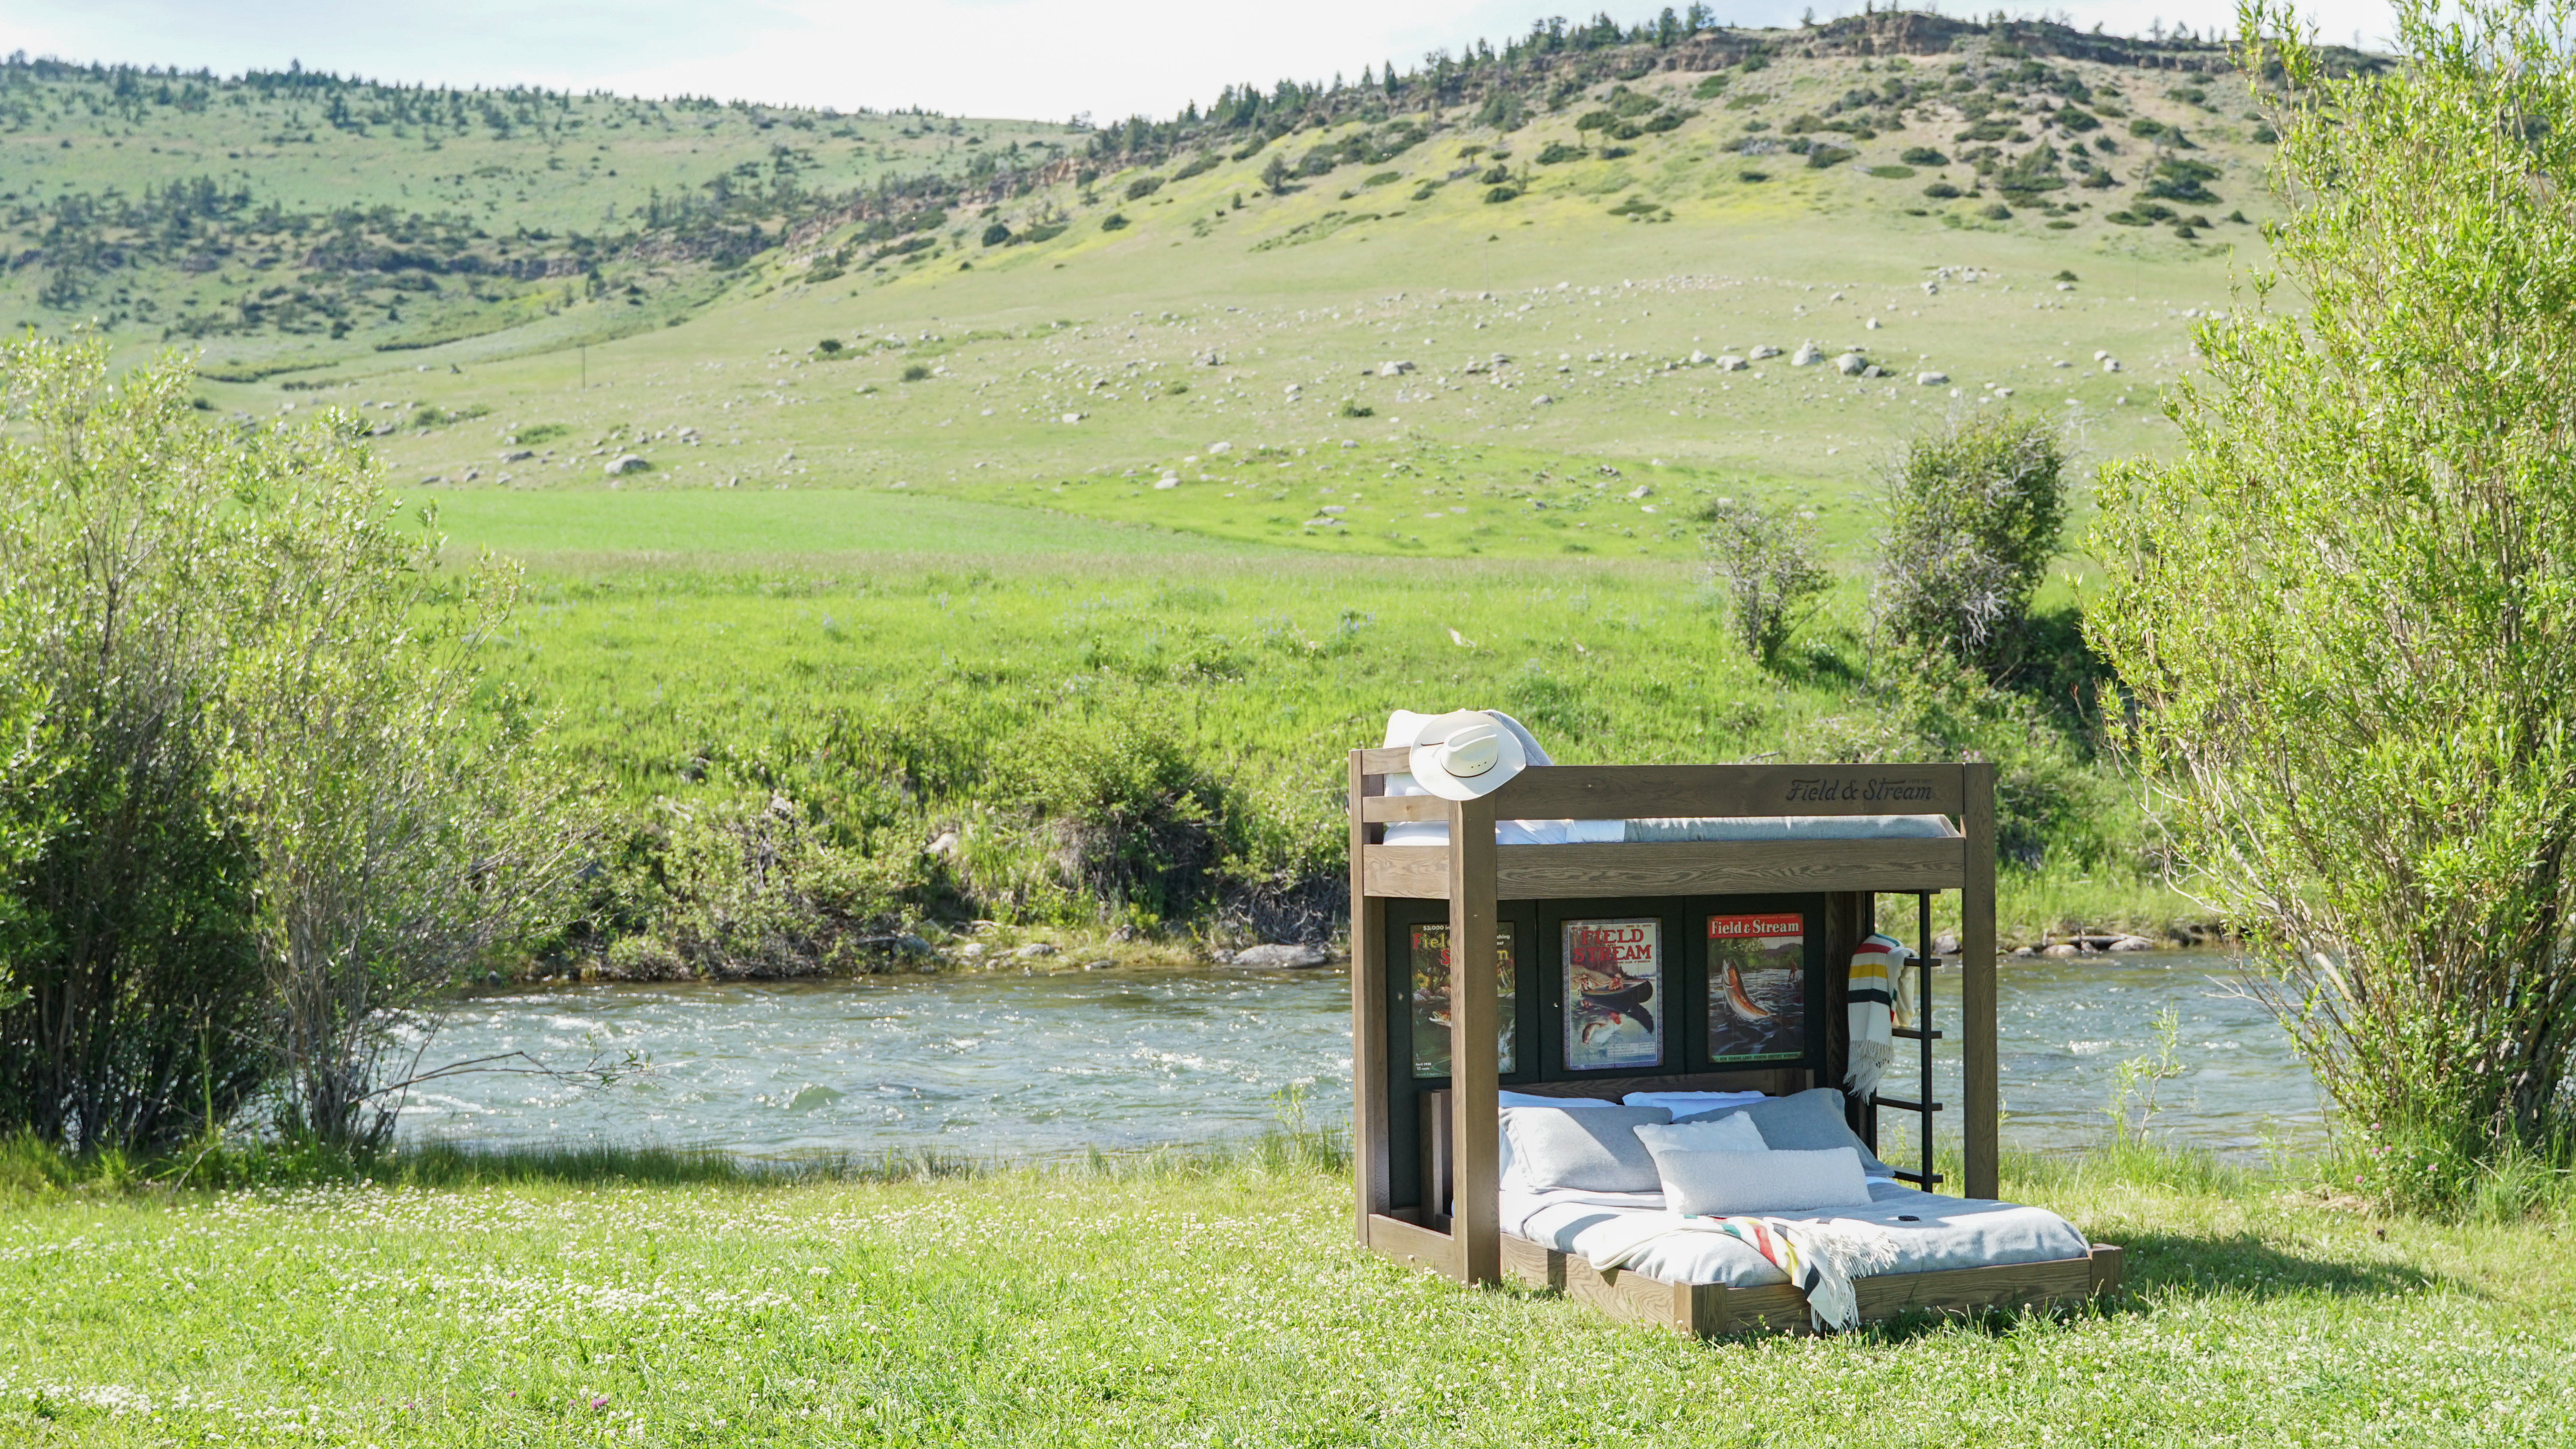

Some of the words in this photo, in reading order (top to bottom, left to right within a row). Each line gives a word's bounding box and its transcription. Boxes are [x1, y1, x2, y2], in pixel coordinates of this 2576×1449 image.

[1786, 779, 1839, 800] Field
[1842, 779, 1859, 800] &
[1863, 778, 1932, 800] Stream
[1711, 921, 1742, 935] Field
[1744, 924, 1751, 934] &
[1753, 919, 1800, 934] Stream
[1581, 928, 1644, 945] FIELD
[1573, 944, 1652, 962] STREAM
